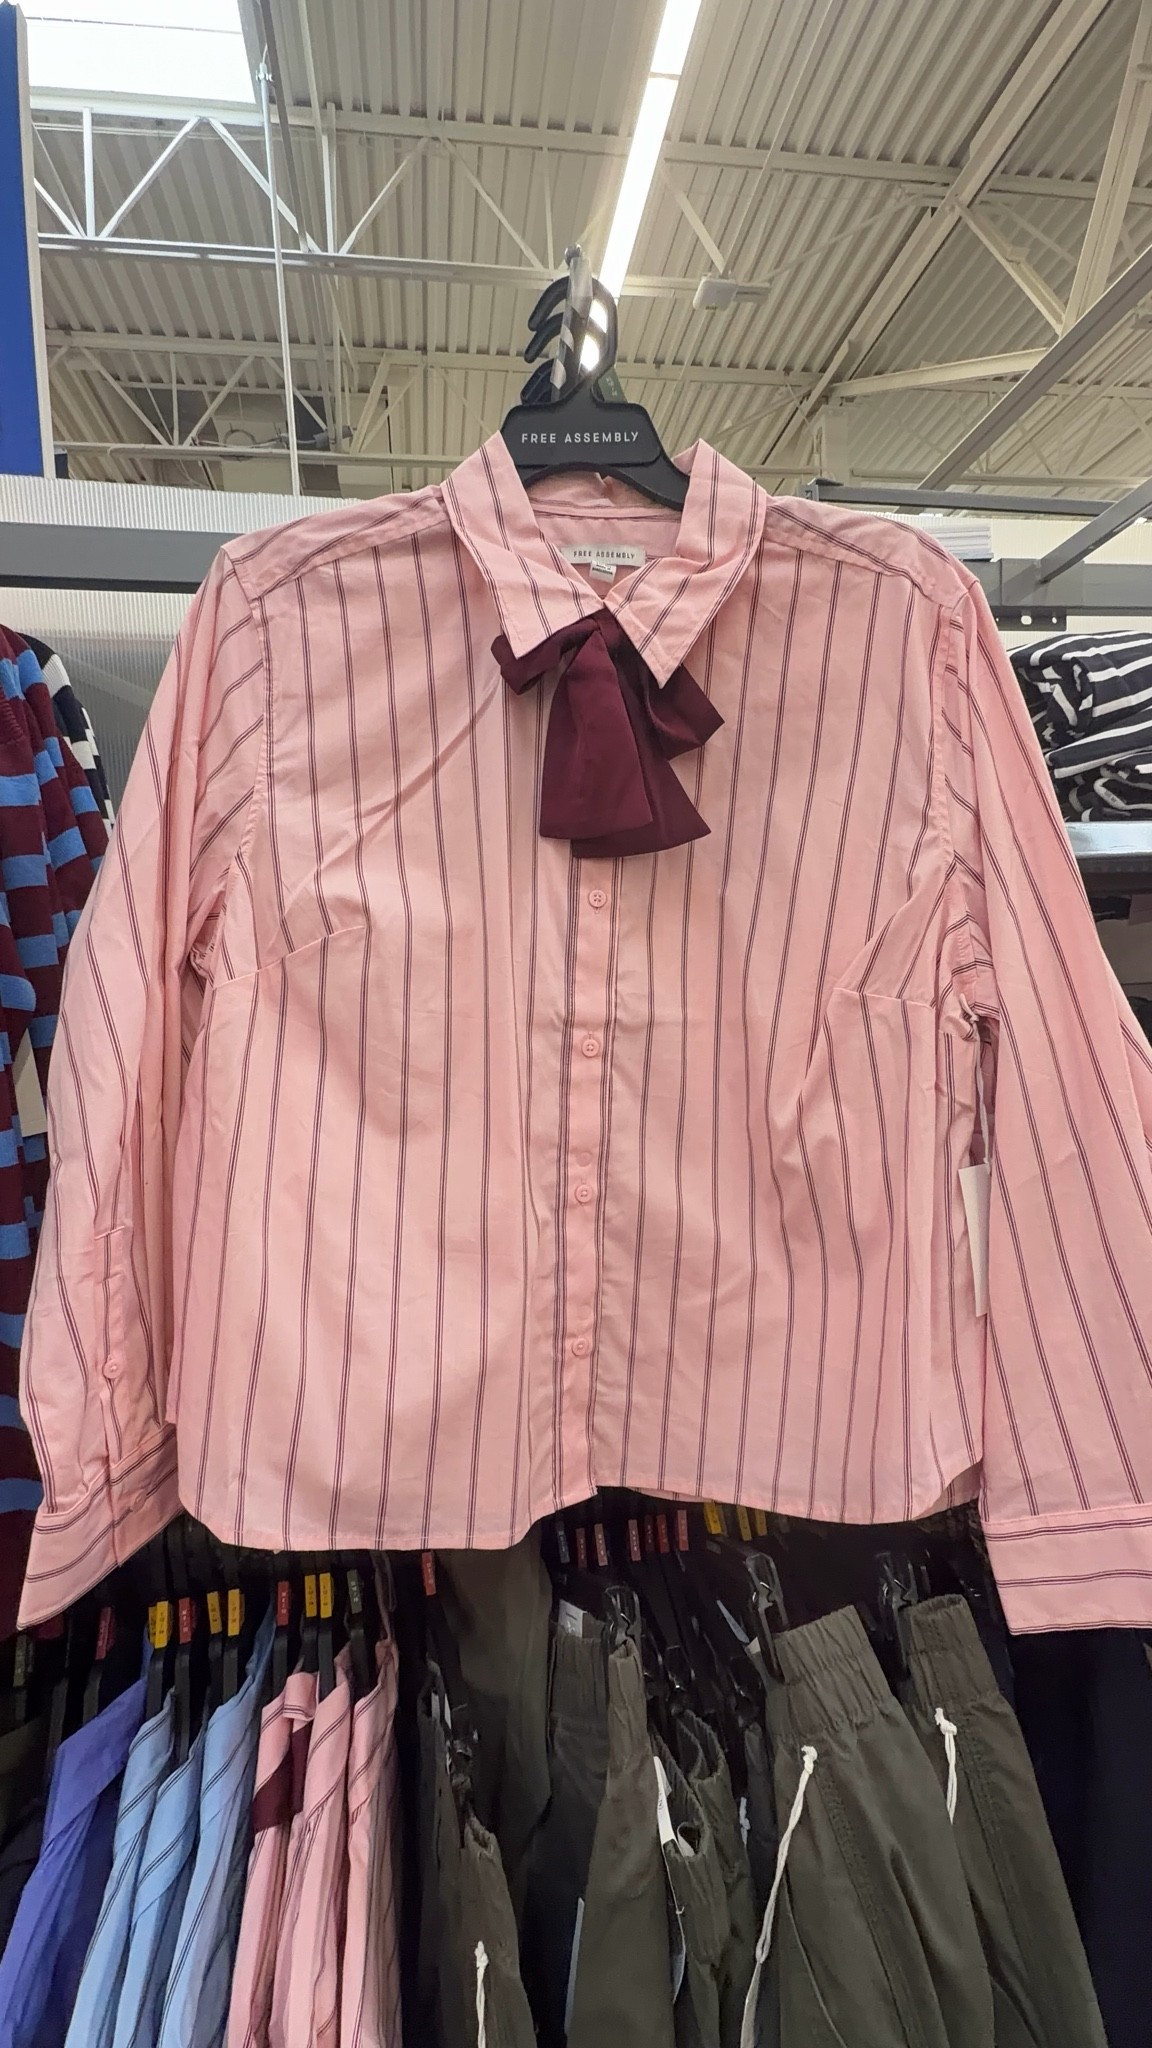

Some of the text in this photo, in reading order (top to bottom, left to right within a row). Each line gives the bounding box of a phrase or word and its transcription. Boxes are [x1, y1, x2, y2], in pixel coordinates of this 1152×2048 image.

[521, 432, 638, 443] FREE ASSEMBLY
[596, 551, 635, 559] ASSEMBLY
